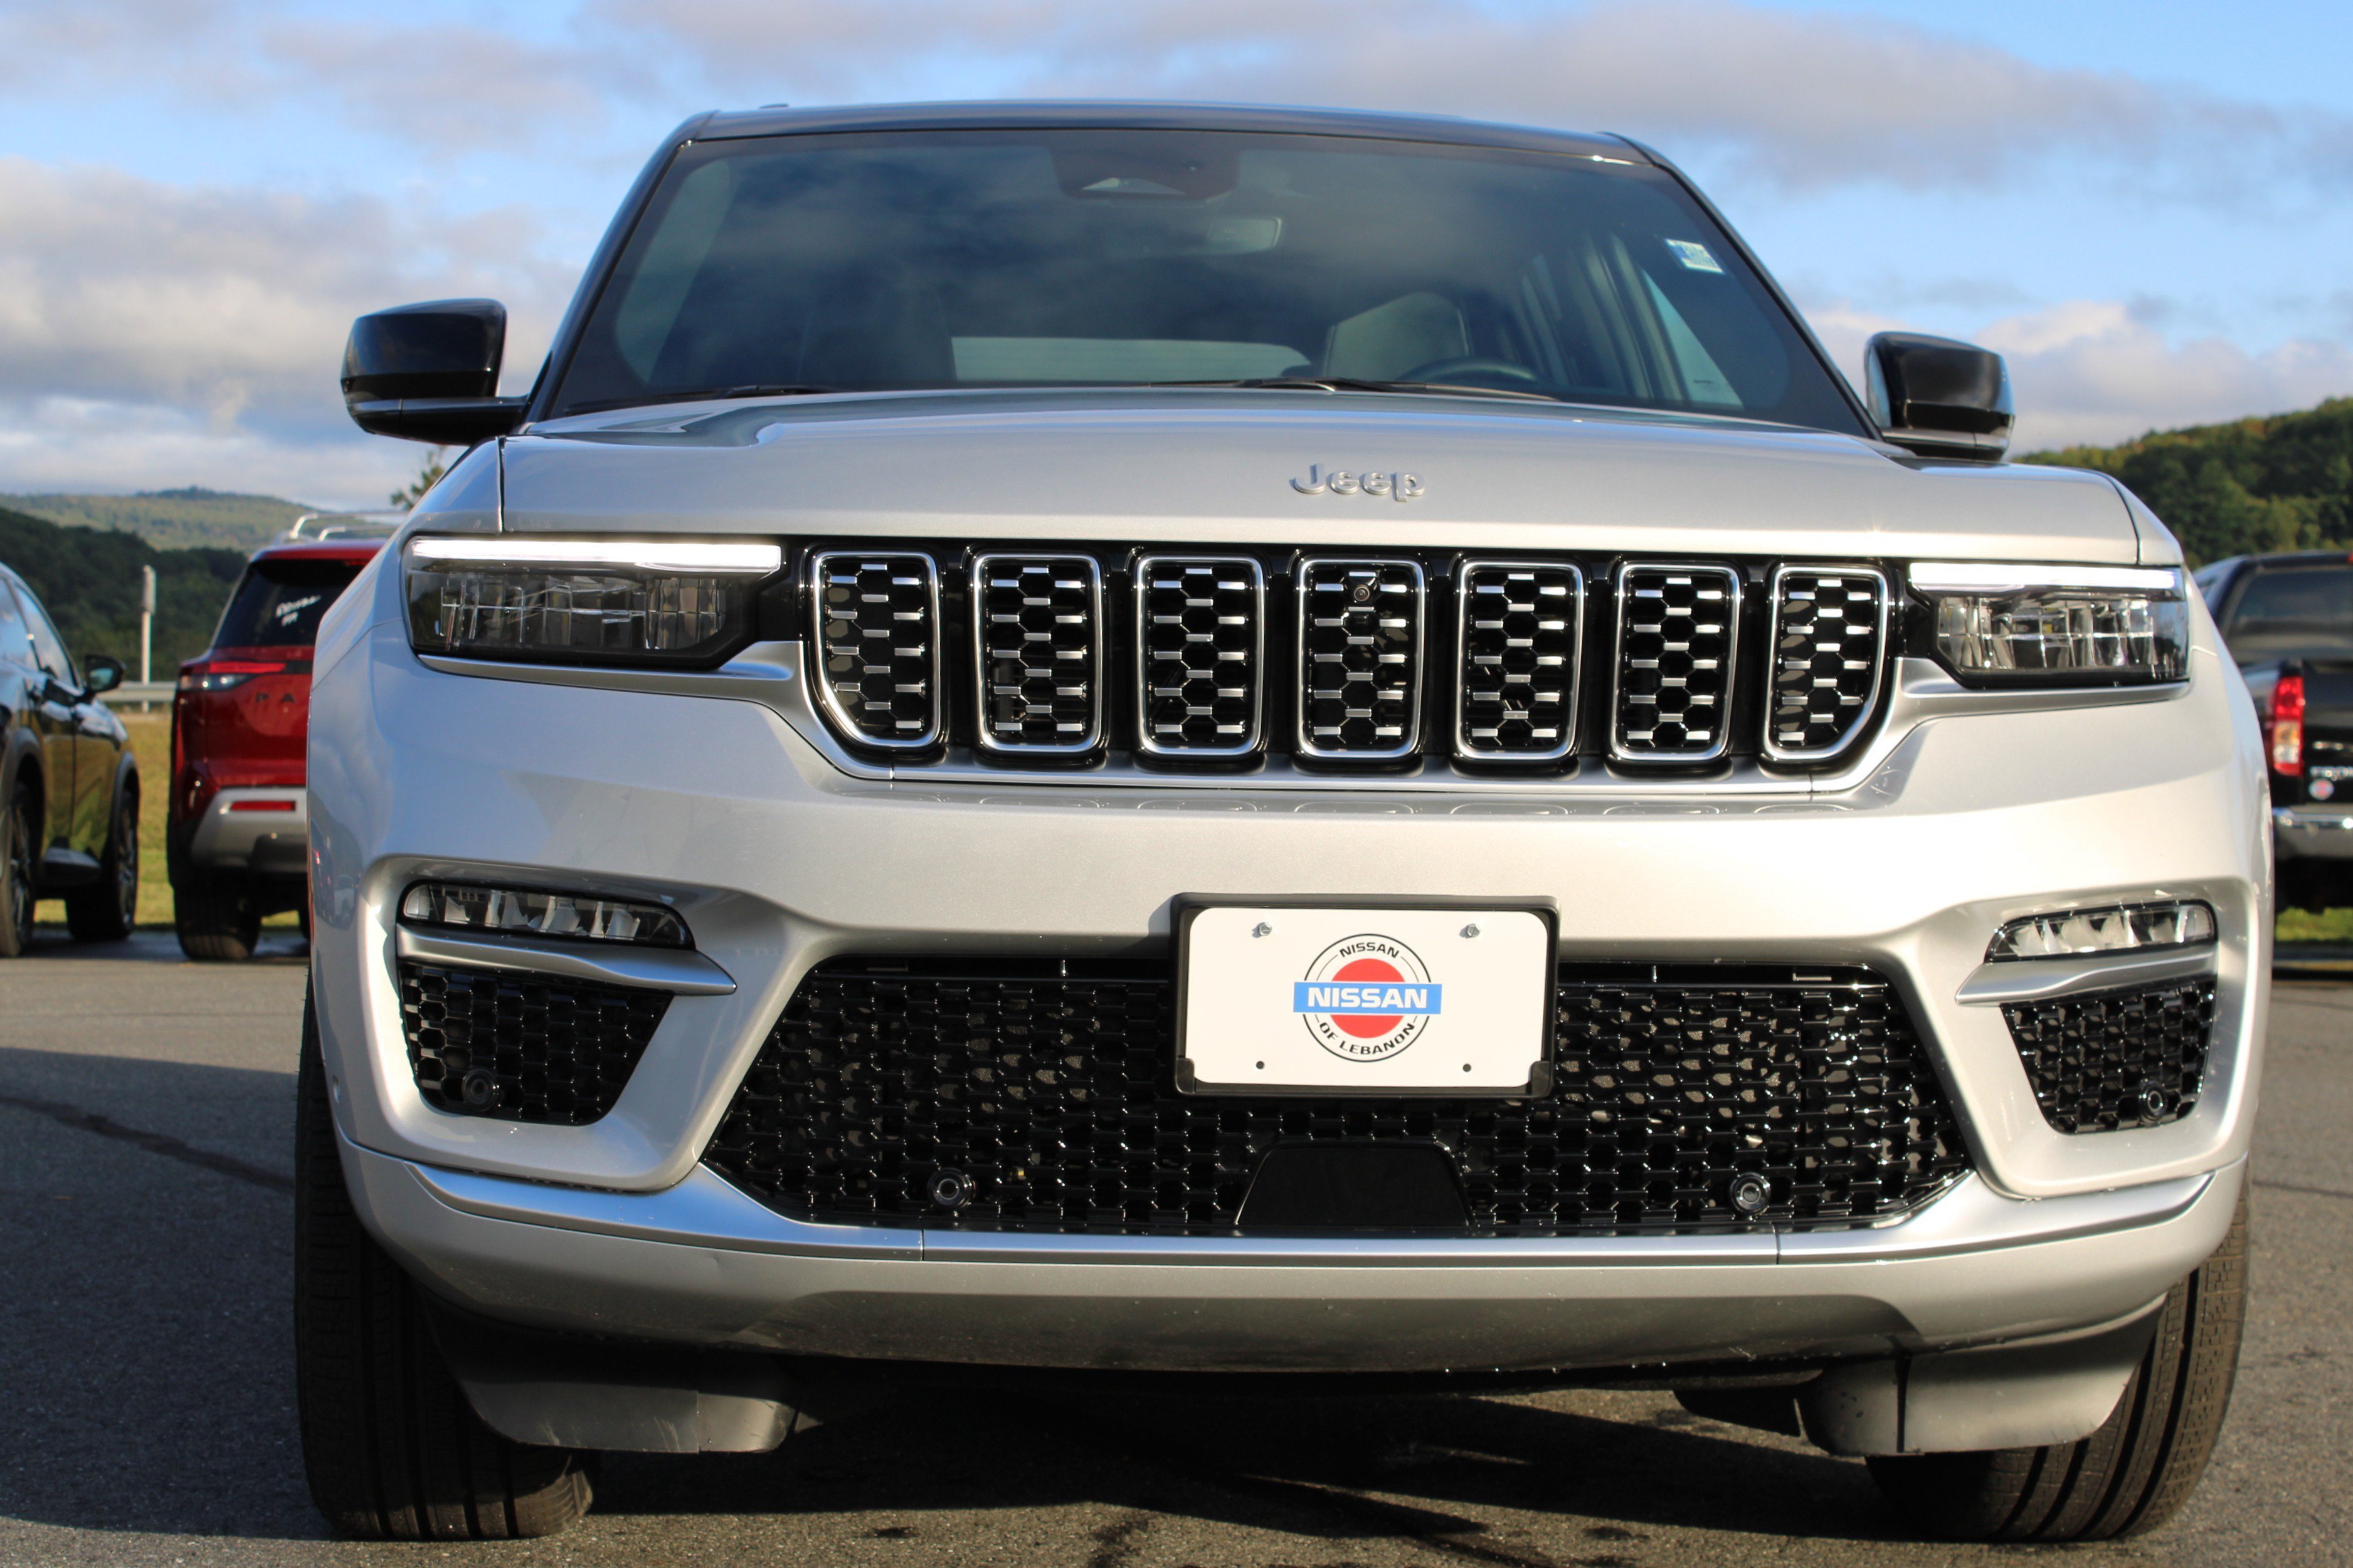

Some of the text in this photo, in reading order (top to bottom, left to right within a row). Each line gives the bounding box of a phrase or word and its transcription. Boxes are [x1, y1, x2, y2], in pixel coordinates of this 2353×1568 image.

[1289, 463, 1425, 502] Jeep
[1340, 942, 1399, 959] NISSAN
[1308, 987, 1427, 1009] NISSAN
[1319, 1022, 1415, 1055] OF LEBANON
